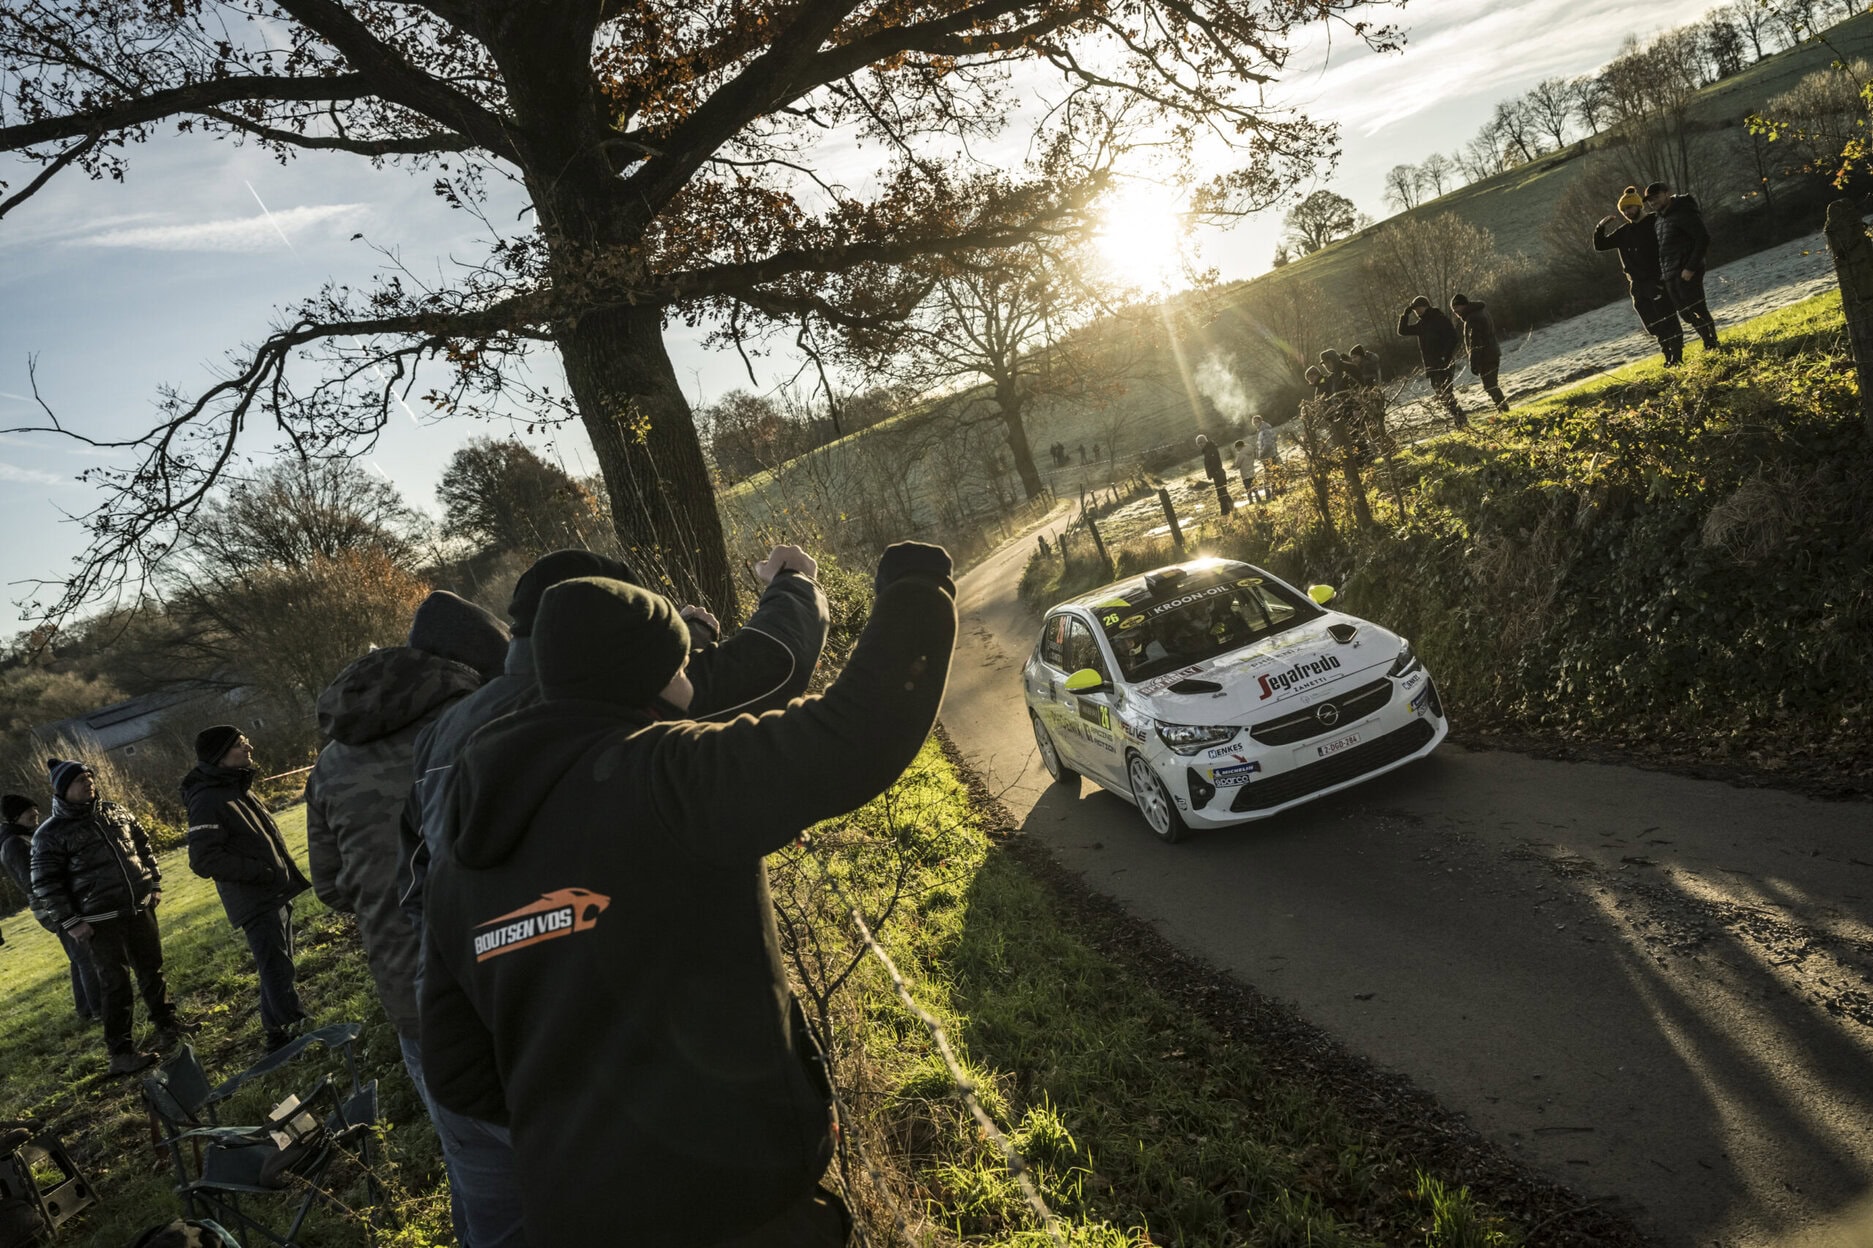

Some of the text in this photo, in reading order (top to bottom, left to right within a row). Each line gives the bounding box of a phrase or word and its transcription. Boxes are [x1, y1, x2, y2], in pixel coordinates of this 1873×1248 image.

[1153, 585, 1230, 614] KROON-OIL
[1103, 613, 1120, 627] 26
[1257, 654, 1341, 701] Segafredo
[1294, 677, 1327, 692] ZANETTI
[1207, 742, 1243, 759] HENKES
[1221, 765, 1254, 775] MICHELIN
[1215, 775, 1249, 786] sparco
[474, 917, 535, 956] BOUTSEN
